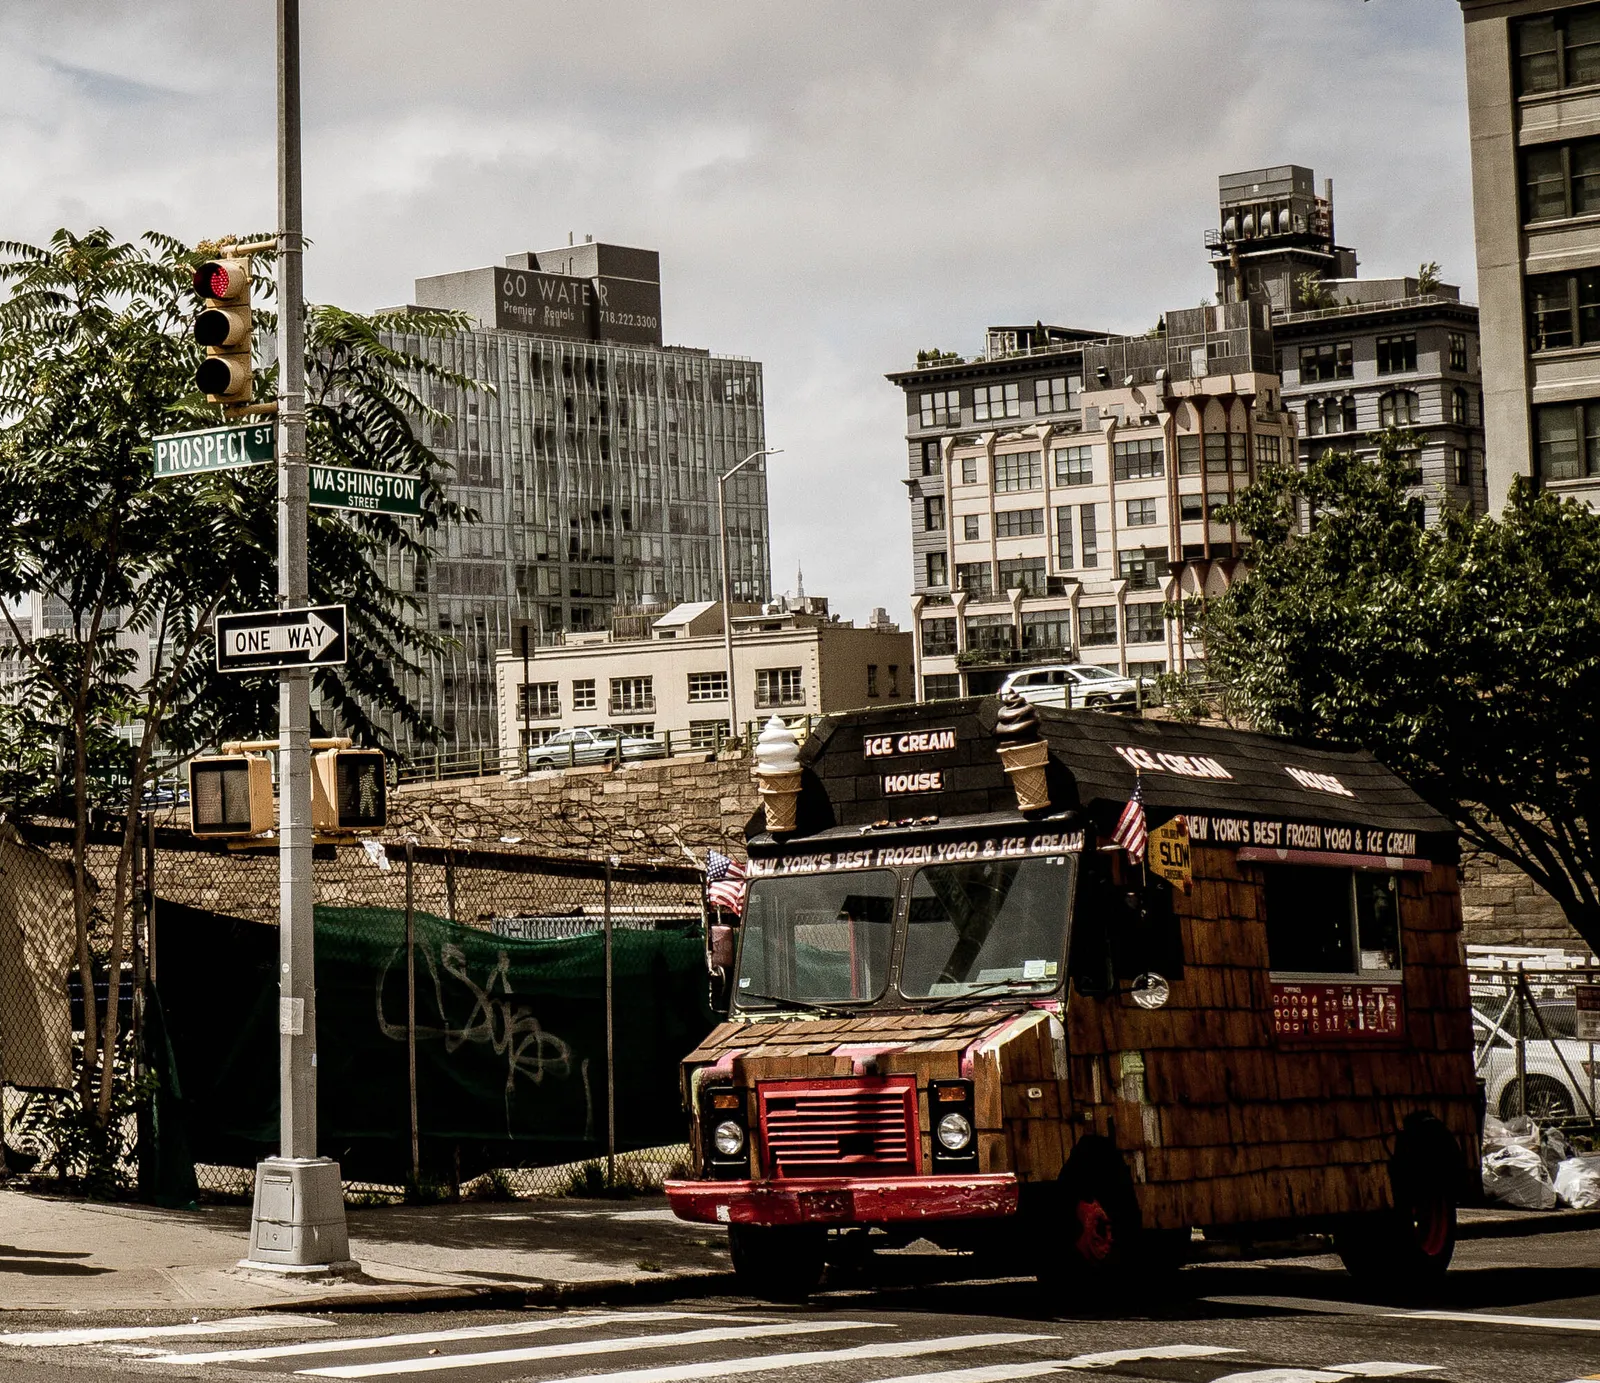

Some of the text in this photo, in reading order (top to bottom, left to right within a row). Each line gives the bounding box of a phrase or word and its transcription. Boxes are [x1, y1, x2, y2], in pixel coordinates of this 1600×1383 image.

[503, 273, 609, 307] 60 WATER
[504, 301, 536, 316] Premier
[544, 305, 575, 321] Rentals
[600, 310, 657, 329] 718.222.3300
[157, 428, 271, 472] PROSPECT ST
[313, 468, 414, 500] WASHINGTON
[348, 495, 379, 509] STREET
[236, 626, 325, 652] ONE WAY
[898, 731, 955, 753] CREAM
[885, 772, 942, 793] HOUSE
[1156, 752, 1234, 779] CREAM
[1284, 766, 1355, 797] HOUSE
[1186, 815, 1209, 840] NEW
[1212, 817, 1250, 843] YORK'S
[1253, 821, 1283, 845] BEST
[1286, 823, 1321, 848] FROZEN
[1324, 827, 1352, 851] YOGO
[1355, 829, 1363, 851] &
[1387, 832, 1416, 855] CREAM
[746, 858, 778, 876] NEW
[782, 853, 831, 874] YORK'S
[836, 849, 874, 869] BEST
[876, 845, 932, 866] FROZEN
[938, 841, 978, 861] YOGO
[983, 840, 995, 857] &
[1031, 831, 1084, 854] CREAM
[1160, 842, 1190, 868] SLOW
